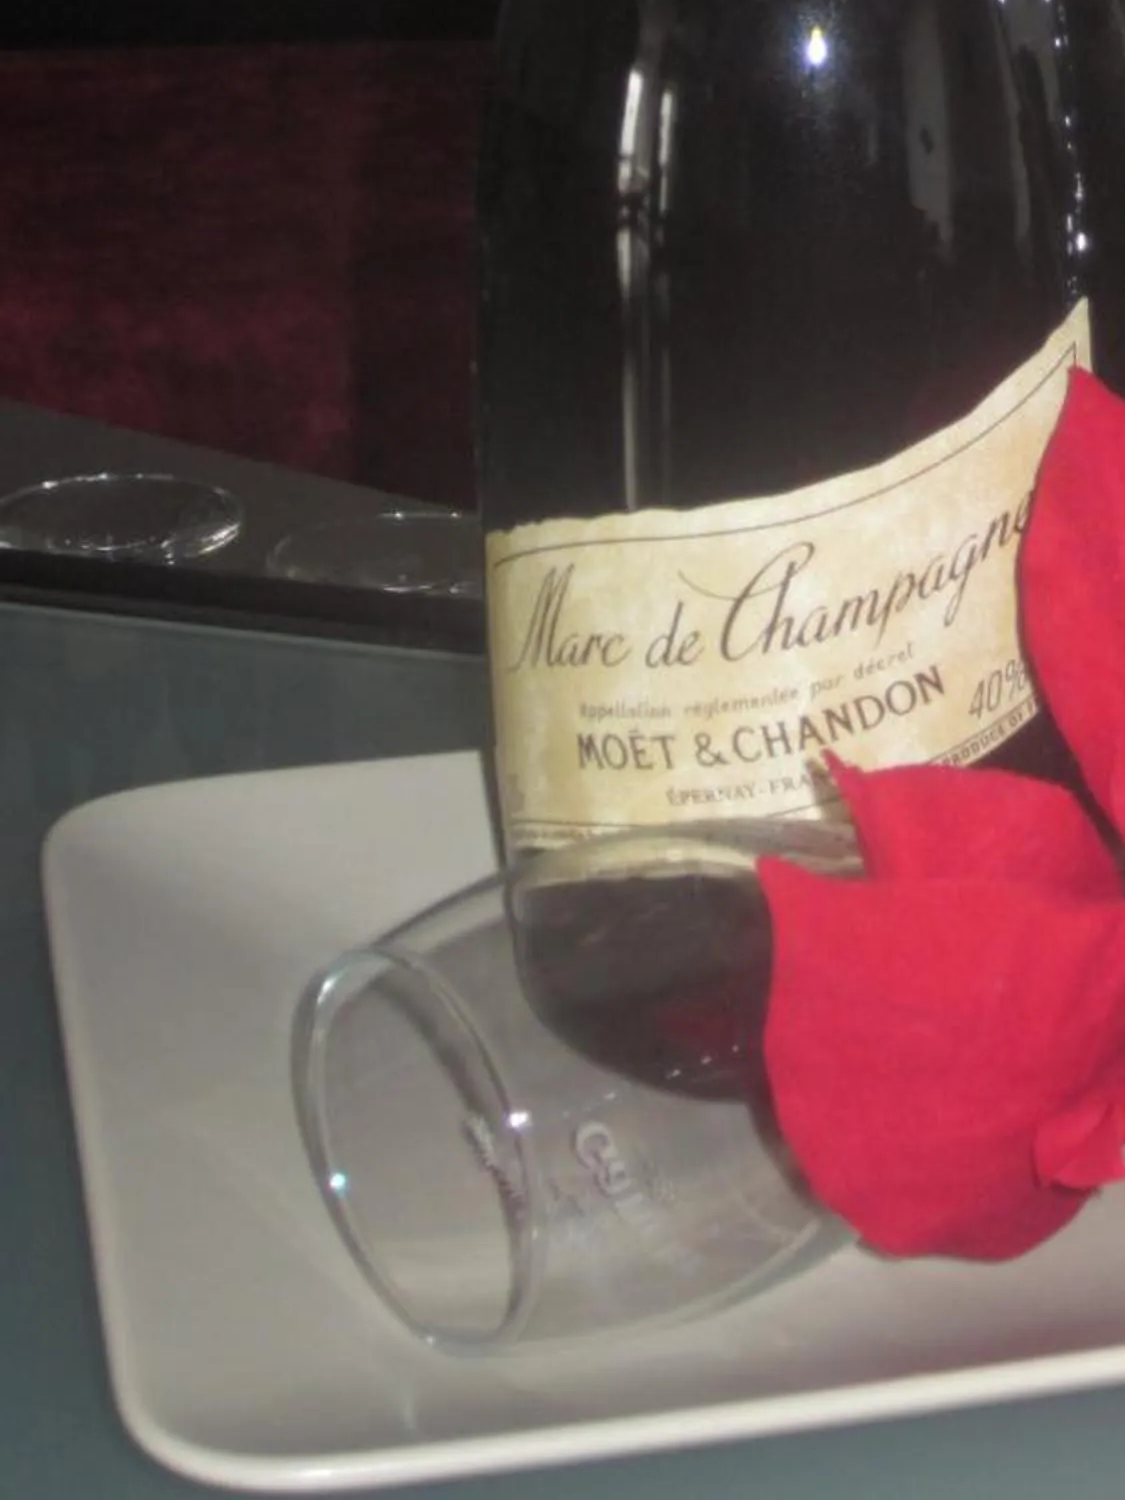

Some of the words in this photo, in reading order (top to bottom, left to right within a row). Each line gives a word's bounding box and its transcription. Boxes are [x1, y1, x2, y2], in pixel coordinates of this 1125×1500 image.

[509, 562, 633, 672] Marc
[644, 600, 706, 669] de
[677, 494, 1030, 664] Champagne
[694, 732, 728, 767] &
[731, 664, 946, 763] CHANDON
[810, 673, 845, 701] par
[852, 641, 917, 681] décret
